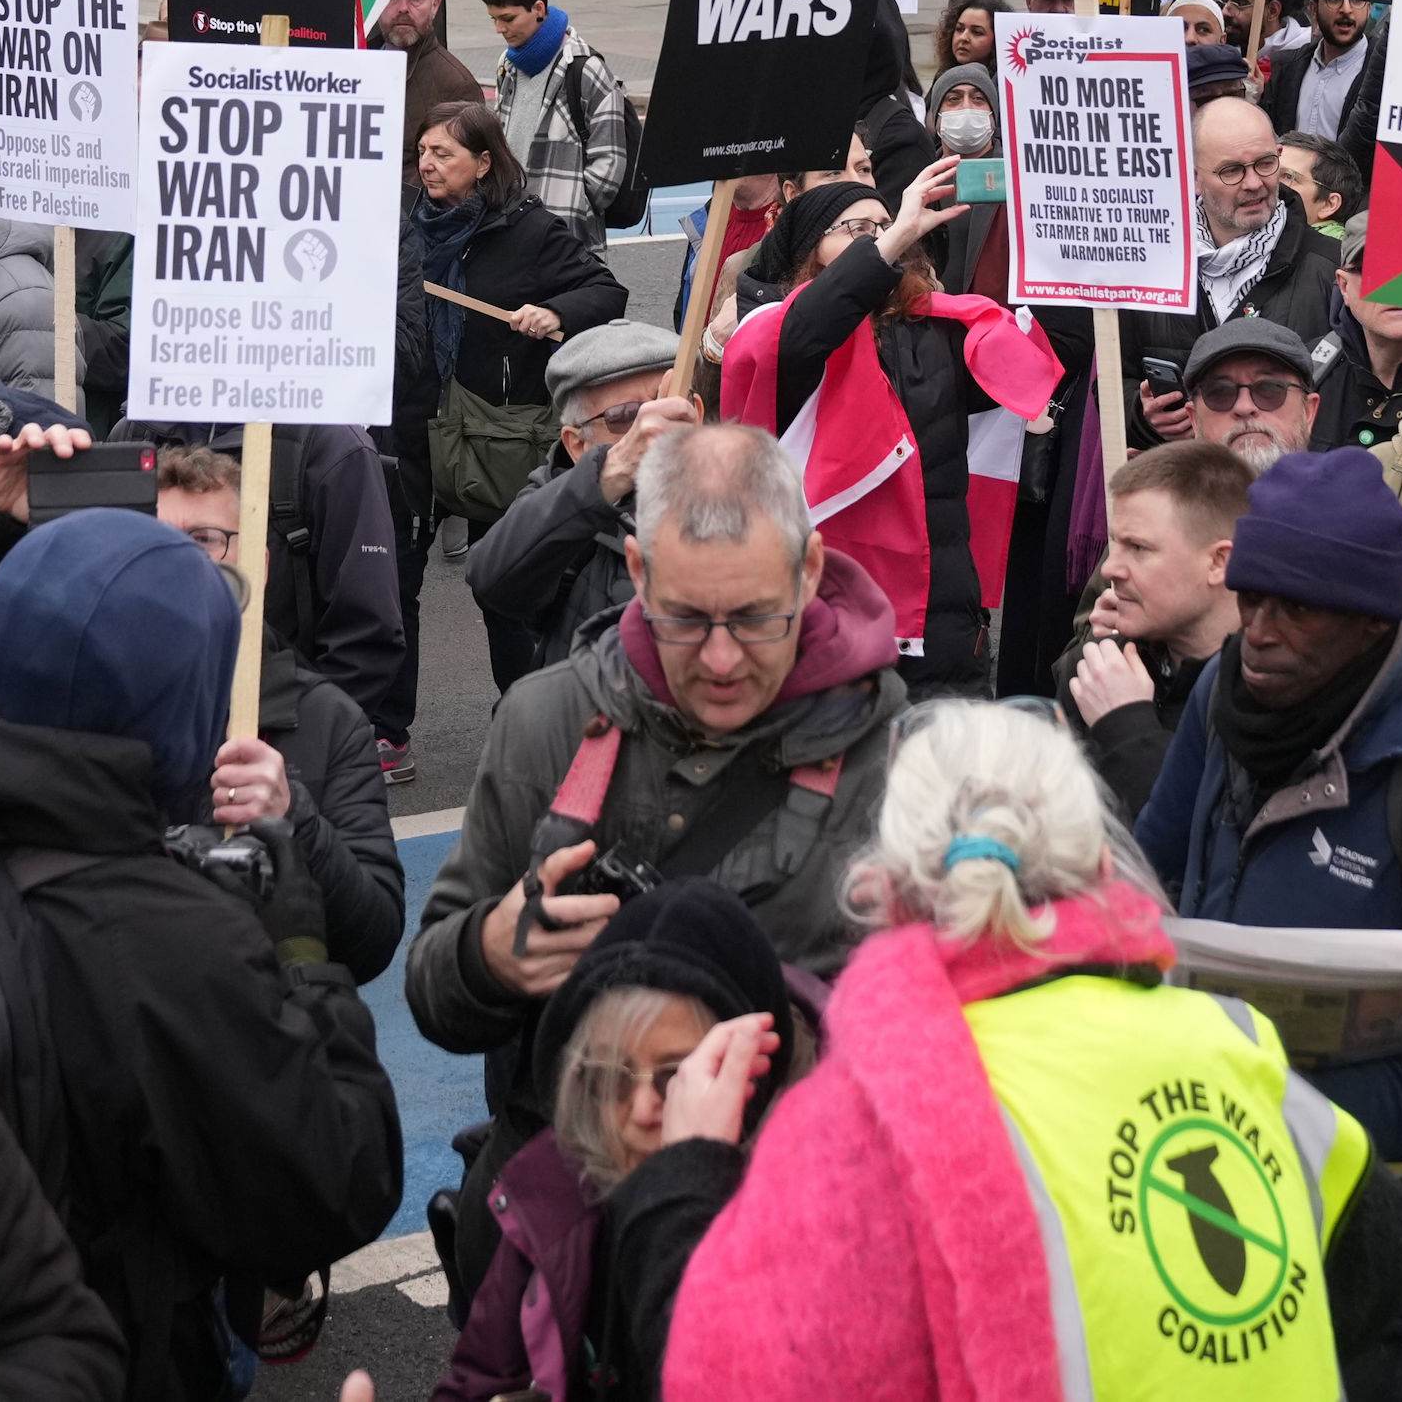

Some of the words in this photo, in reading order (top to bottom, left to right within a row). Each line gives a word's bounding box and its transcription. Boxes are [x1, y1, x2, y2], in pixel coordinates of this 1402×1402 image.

[210, 18, 234, 33] Stop
[236, 22, 254, 32] the
[289, 28, 327, 40] oalition
[63, 30, 102, 76] ON
[1030, 30, 1123, 51] Socialist
[1026, 47, 1087, 64] Party
[189, 66, 283, 90] Socialist
[284, 71, 361, 94] Worker
[1040, 76, 1070, 106] NO
[1077, 78, 1144, 109] MORE
[160, 97, 282, 156] STOP
[300, 102, 385, 159] THE
[1030, 110, 1079, 142] WAR
[1087, 112, 1111, 141] IN
[1118, 114, 1162, 143] THE
[51, 136, 70, 158] US
[76, 139, 101, 160] and
[703, 135, 785, 157] www.stopwar.org.uk
[45, 160, 130, 190] imperialism
[1025, 144, 1109, 176] MIDDLE
[1117, 147, 1173, 178] EAST
[32, 190, 99, 219] Palestine
[157, 161, 260, 219] WAR
[279, 164, 342, 222] ON
[1045, 185, 1077, 203] BUILD
[1082, 187, 1089, 203] A
[1093, 187, 1154, 206] SOCIALIST
[1030, 203, 1102, 221] ALTERNATIVE
[1108, 206, 1123, 222] TO
[1127, 206, 1175, 227] TRUMP,
[1035, 222, 1088, 242] STARMER
[1093, 225, 1116, 243] AND
[1120, 226, 1140, 243] ALL
[1145, 226, 1171, 244] THE
[155, 225, 266, 282] IRAN
[1060, 242, 1147, 263] WARMONGERS
[1025, 282, 1183, 305] www.socialistparty.org.uk
[152, 298, 241, 335] Oppose
[251, 301, 282, 331] US
[290, 303, 332, 332] and
[150, 335, 228, 366] Israeli
[236, 338, 376, 371] imperialism
[149, 378, 202, 408] Free
[211, 379, 324, 409] Palestine
[1329, 864, 1373, 888] PARTNERS
[1108, 1121, 1142, 1236] STOP
[1139, 1080, 1211, 1125] THE
[1219, 1092, 1283, 1186] WAR
[1157, 1261, 1309, 1367] COALITION
